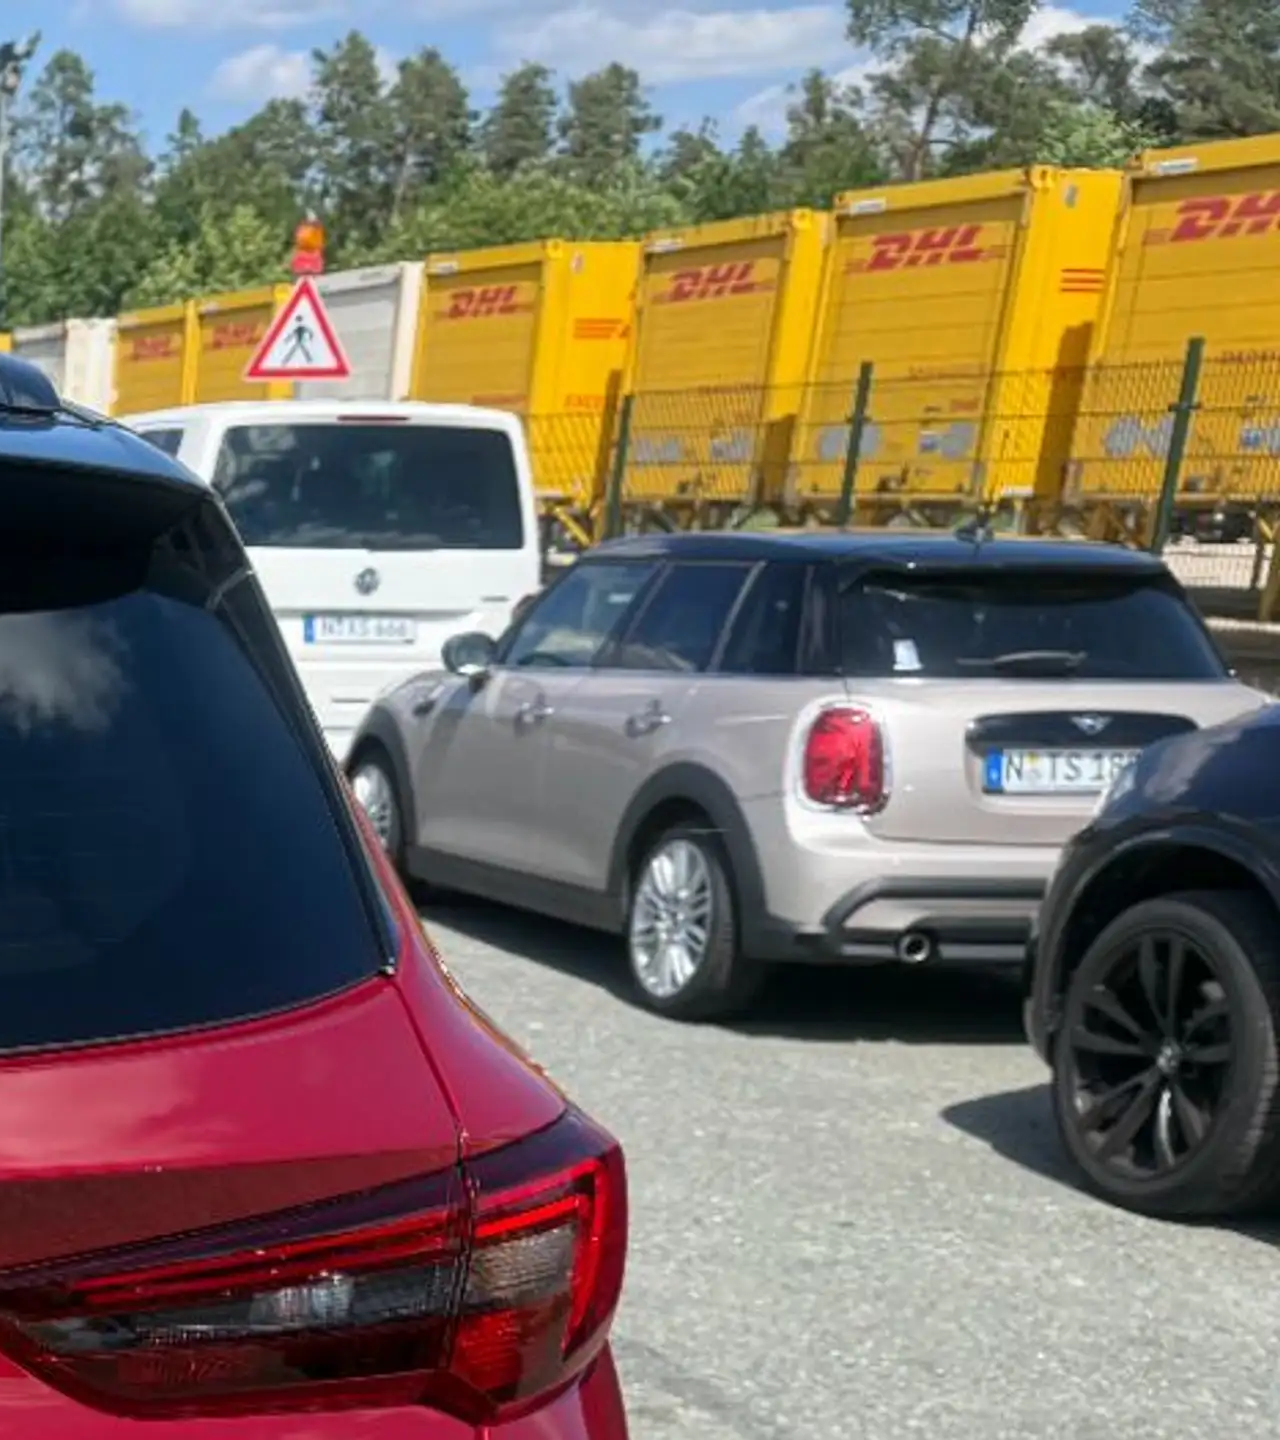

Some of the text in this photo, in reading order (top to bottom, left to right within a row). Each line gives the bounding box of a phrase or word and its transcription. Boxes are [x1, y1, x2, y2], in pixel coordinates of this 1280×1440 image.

[1169, 192, 1280, 243] DH
[867, 225, 984, 271] DHL
[667, 262, 756, 301] DHL
[448, 286, 518, 319] DHL
[1005, 751, 1024, 783] N
